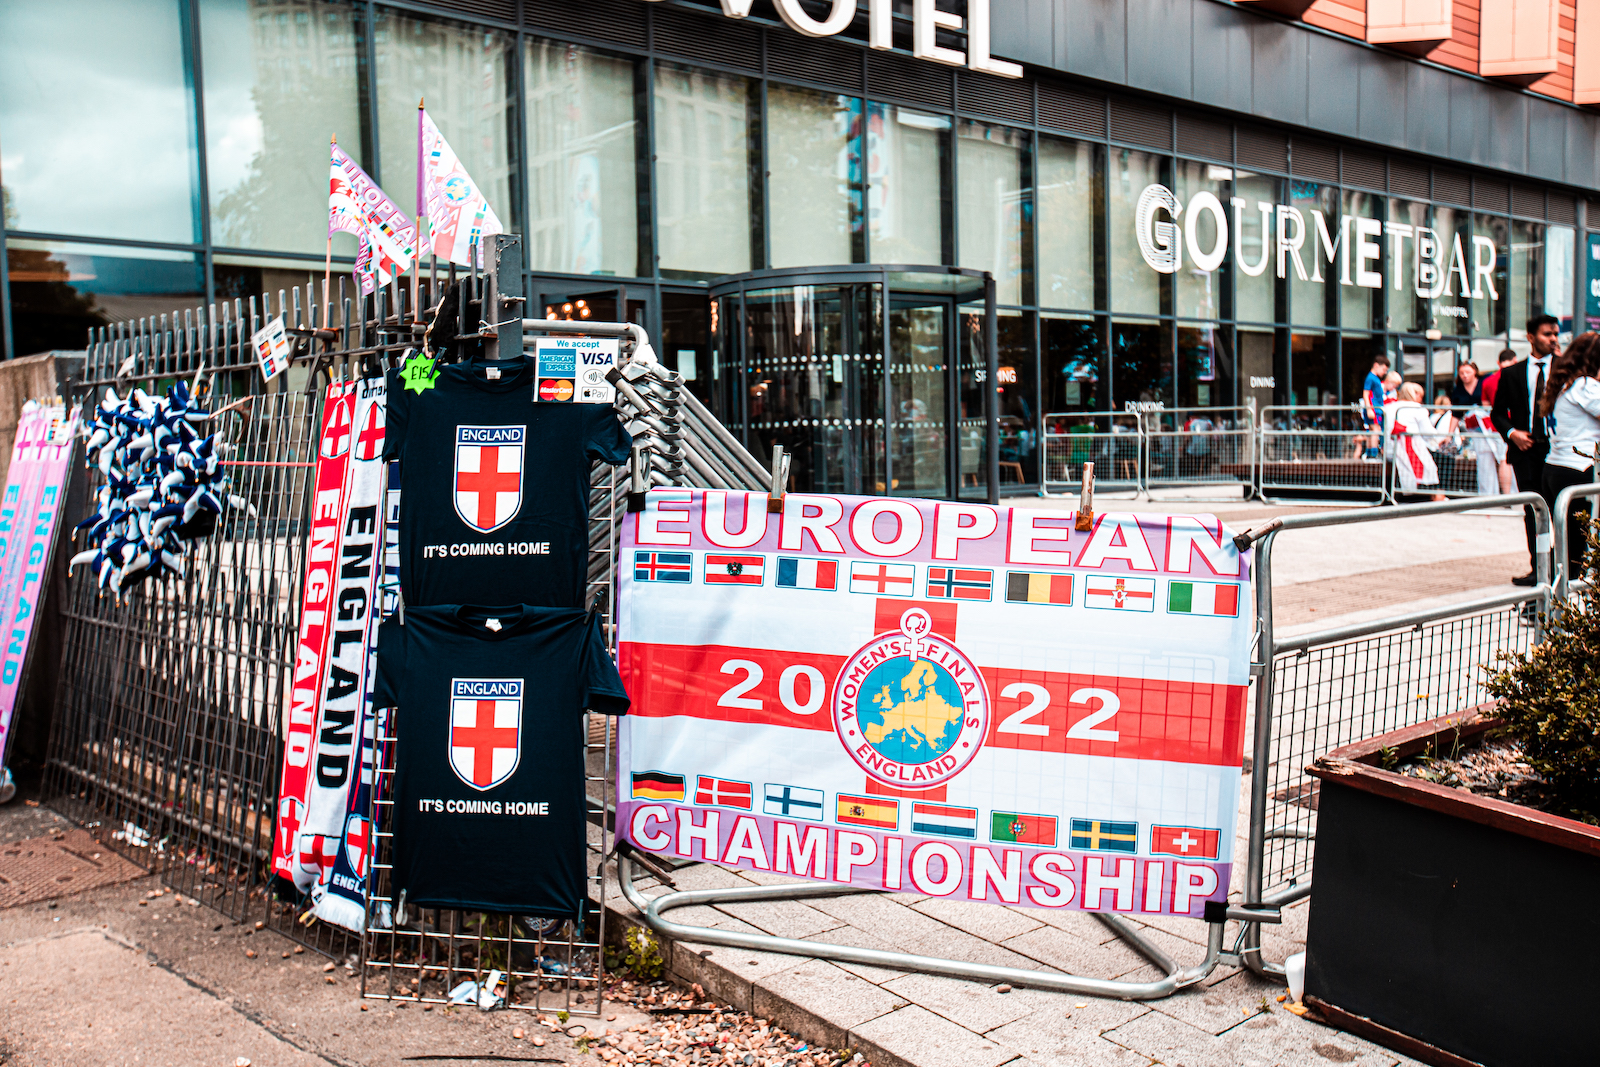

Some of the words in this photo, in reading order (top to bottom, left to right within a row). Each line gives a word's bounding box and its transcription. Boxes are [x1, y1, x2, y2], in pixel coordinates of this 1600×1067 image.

[571, 341, 600, 349] accept
[546, 363, 576, 371] EXPRESS
[579, 353, 614, 365] VISA
[411, 365, 431, 380] £15
[592, 389, 607, 399] Pay
[461, 428, 521, 441] ENGLAND
[635, 489, 1241, 577] EUROPEAN
[423, 544, 448, 558] IT'S
[449, 543, 504, 557] COMING
[507, 542, 550, 555] HOME
[2, 485, 58, 685] ENGLAND
[286, 487, 341, 769] ENGLAND
[316, 504, 377, 789] ENGLAND
[456, 682, 518, 695] ENGLAND
[841, 641, 902, 722] WOMEN'S
[926, 643, 980, 729] FINALS
[716, 658, 826, 715] 20
[996, 682, 1121, 743] 22
[855, 742, 957, 782] ENGLAND
[419, 799, 444, 812] IT'S
[446, 800, 502, 814] COMING
[505, 802, 549, 815] HOME
[630, 804, 1219, 914] CHAMPIONSHIP
